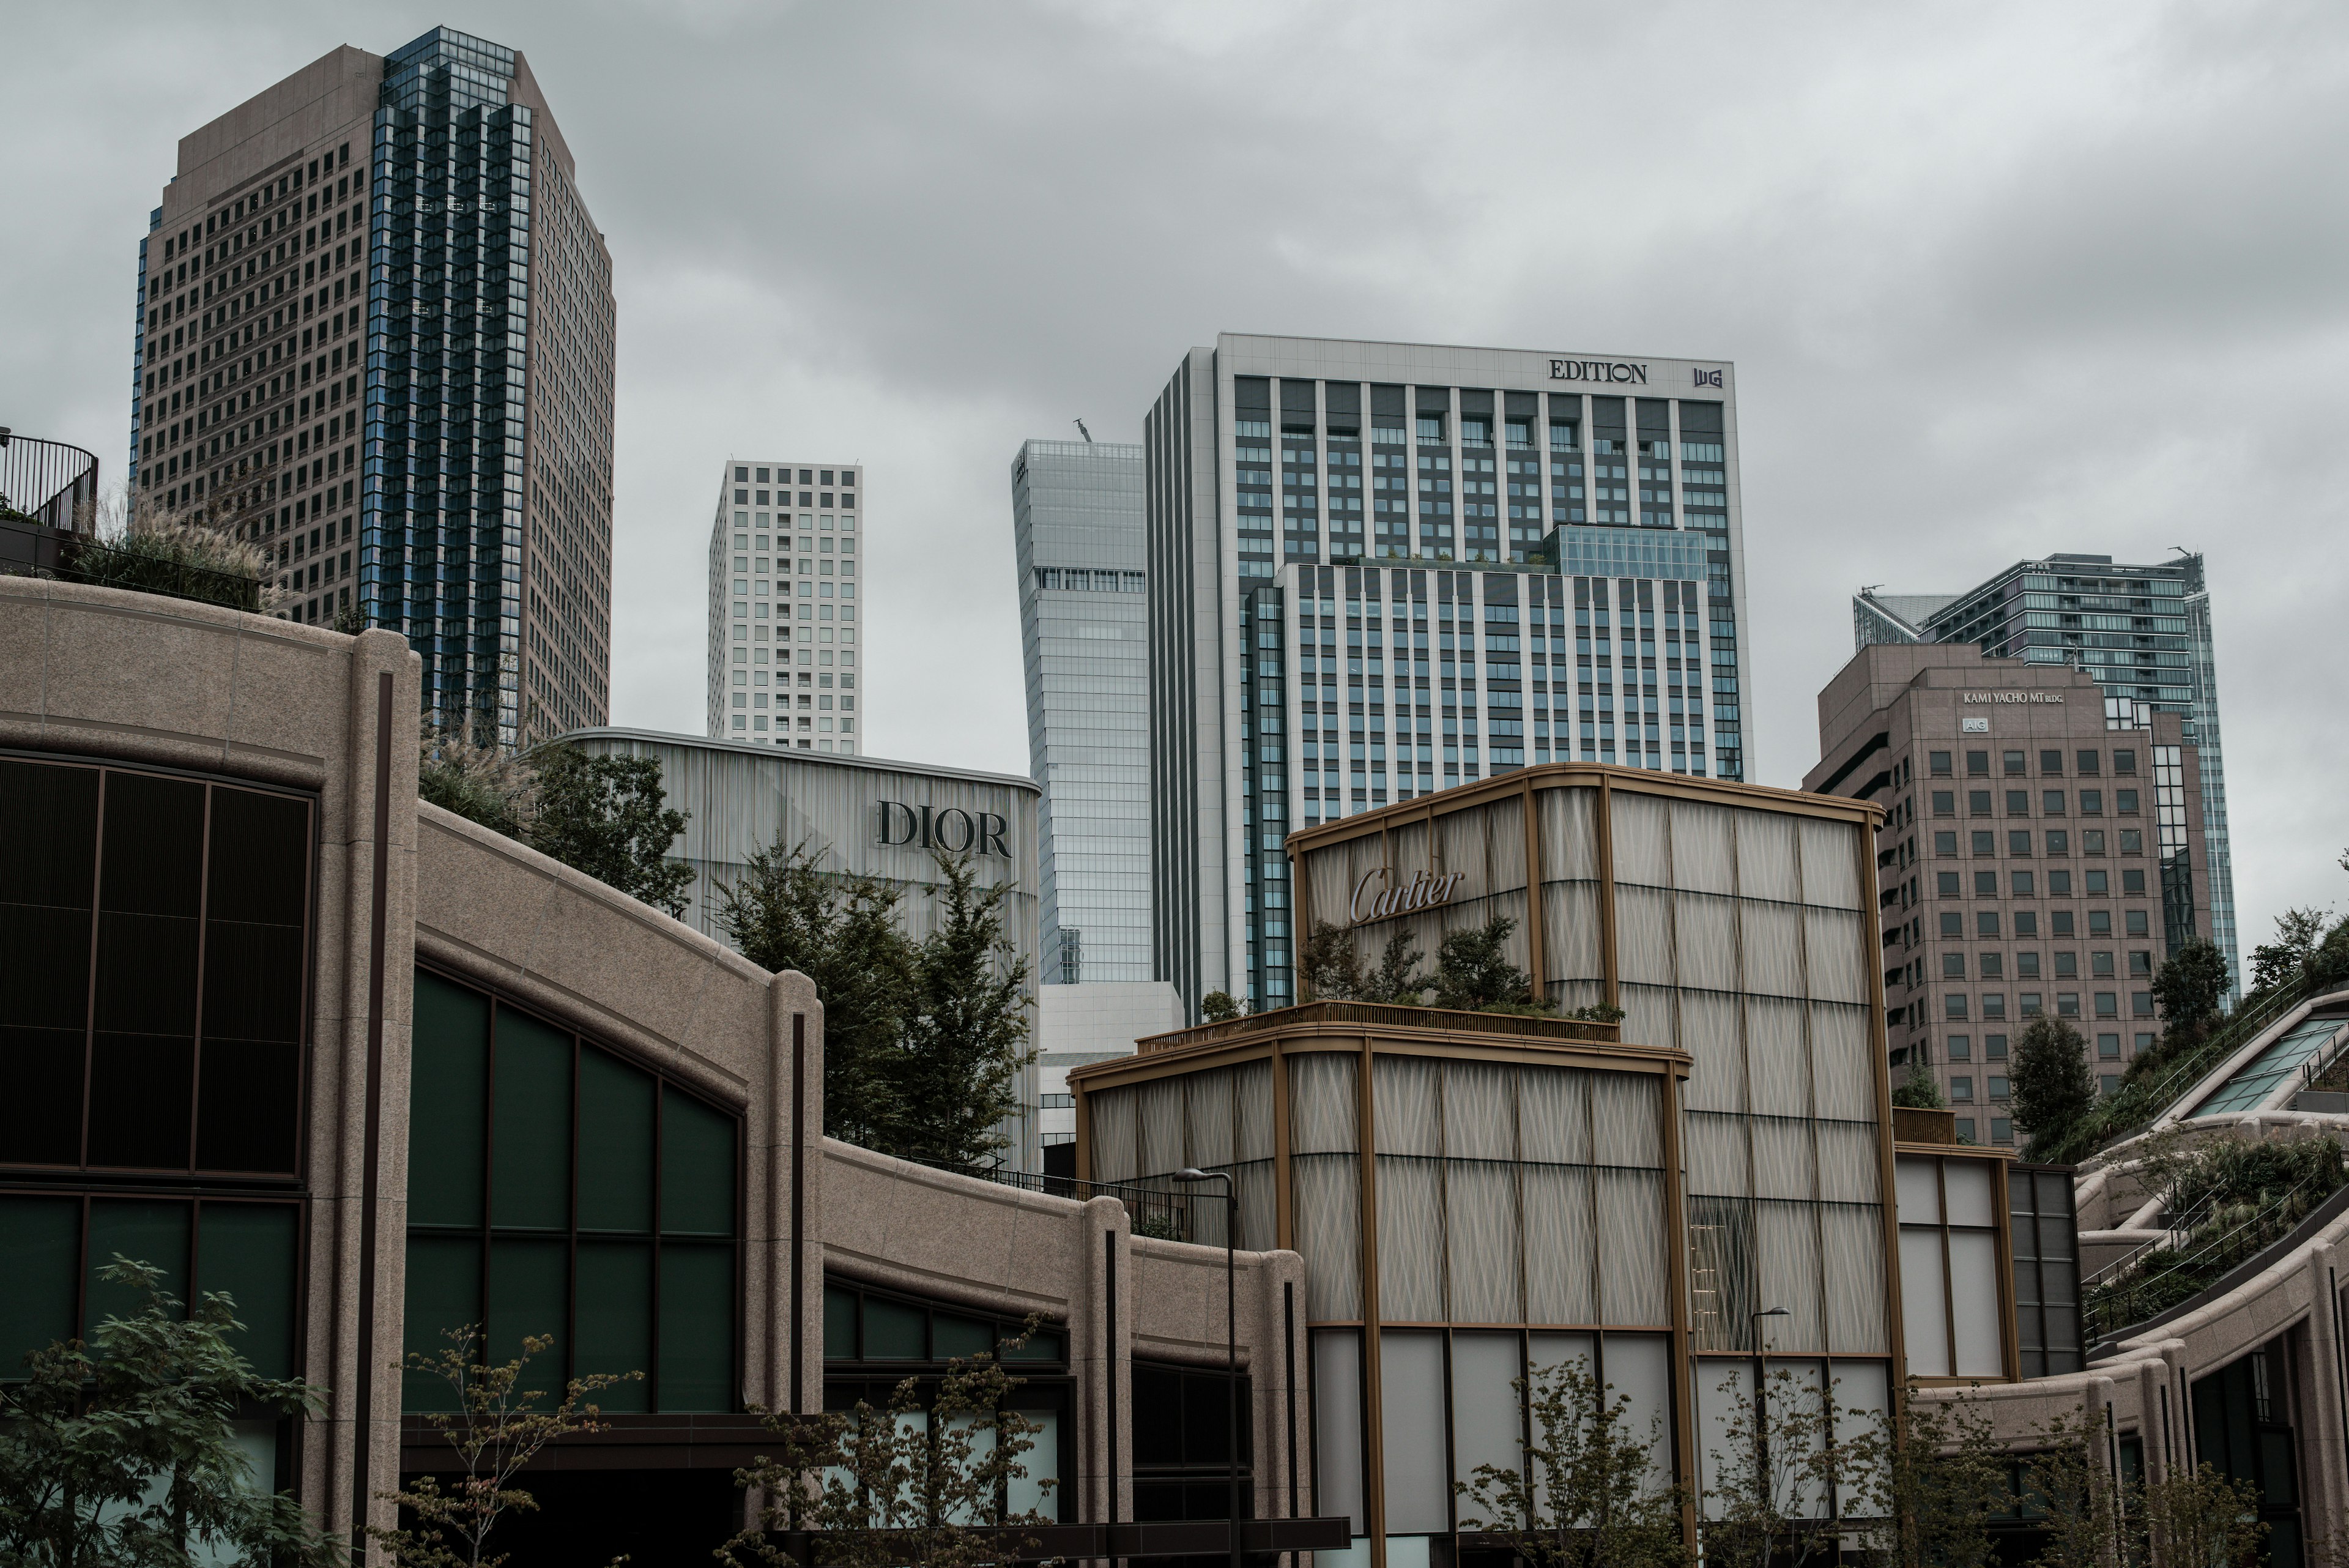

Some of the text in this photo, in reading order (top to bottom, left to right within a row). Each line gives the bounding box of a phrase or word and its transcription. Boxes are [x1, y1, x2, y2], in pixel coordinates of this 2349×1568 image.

[1549, 359, 1647, 384] EDITION
[2030, 693, 2044, 703] MT
[1966, 721, 1986, 730] AIG
[877, 800, 1013, 858] DIOR
[1351, 868, 1466, 923] Cartier
